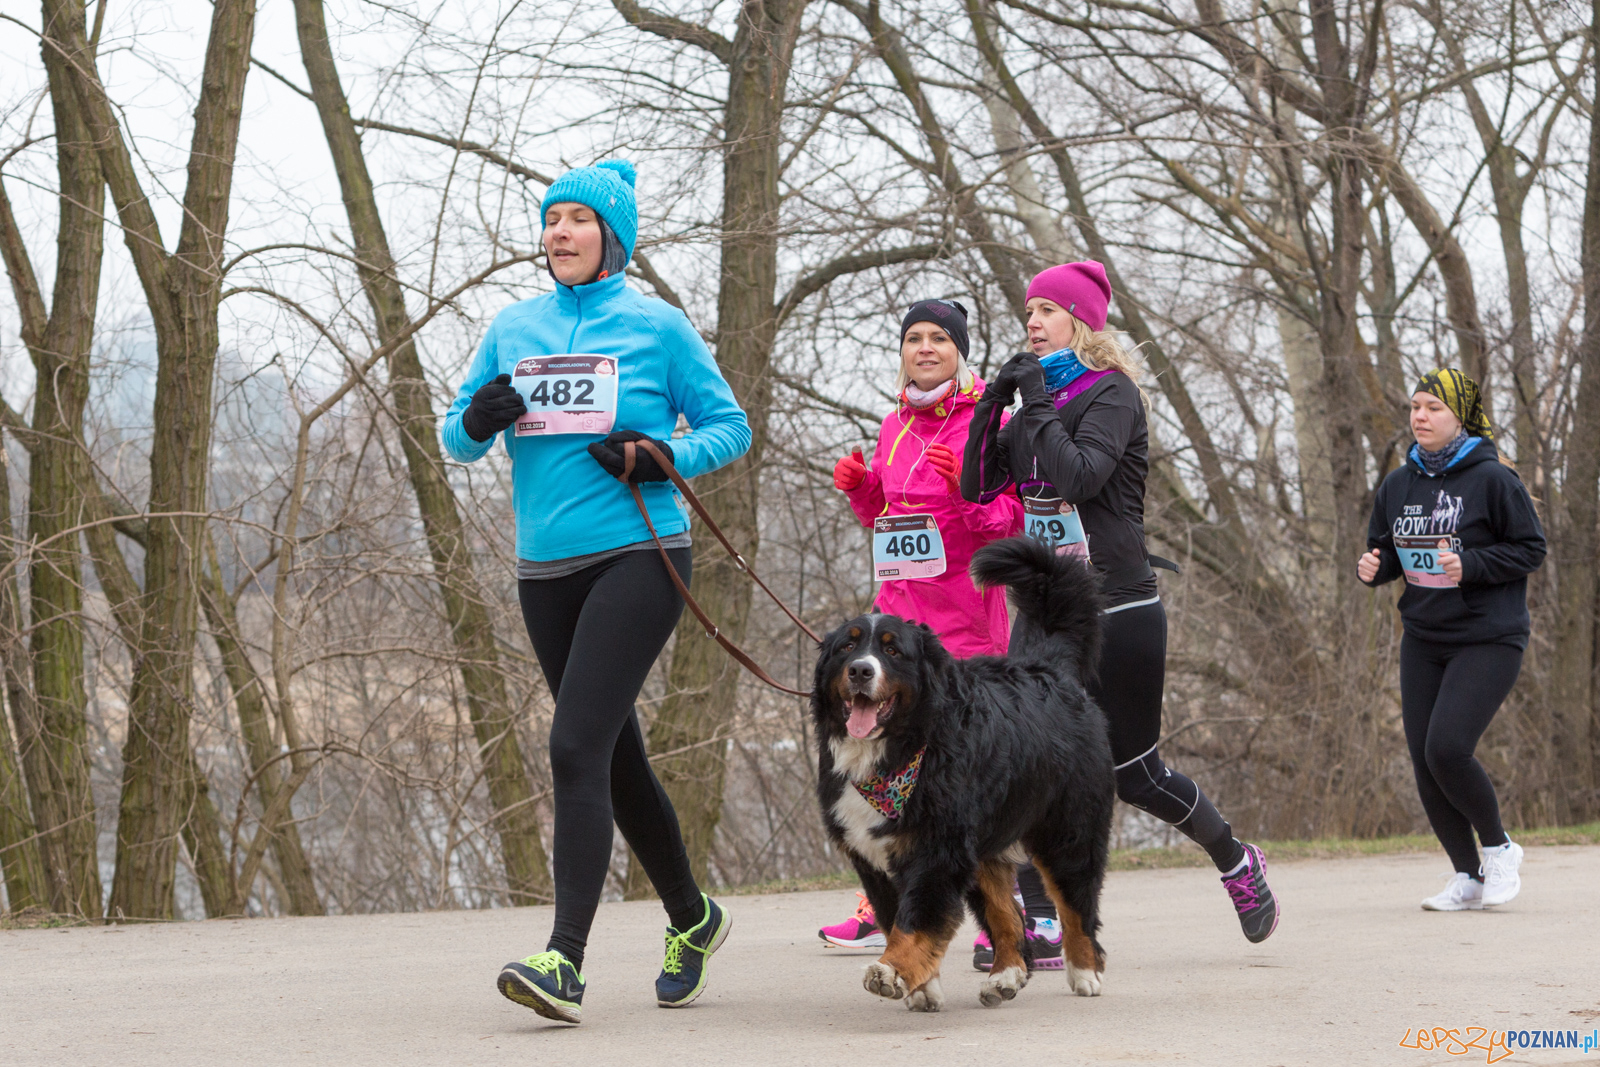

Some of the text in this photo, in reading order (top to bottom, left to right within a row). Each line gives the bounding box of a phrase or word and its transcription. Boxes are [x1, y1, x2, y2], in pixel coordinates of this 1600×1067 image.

[530, 379, 595, 407] 482
[1403, 504, 1423, 515] THE
[886, 533, 931, 557] 460
[1411, 552, 1434, 569] 20
